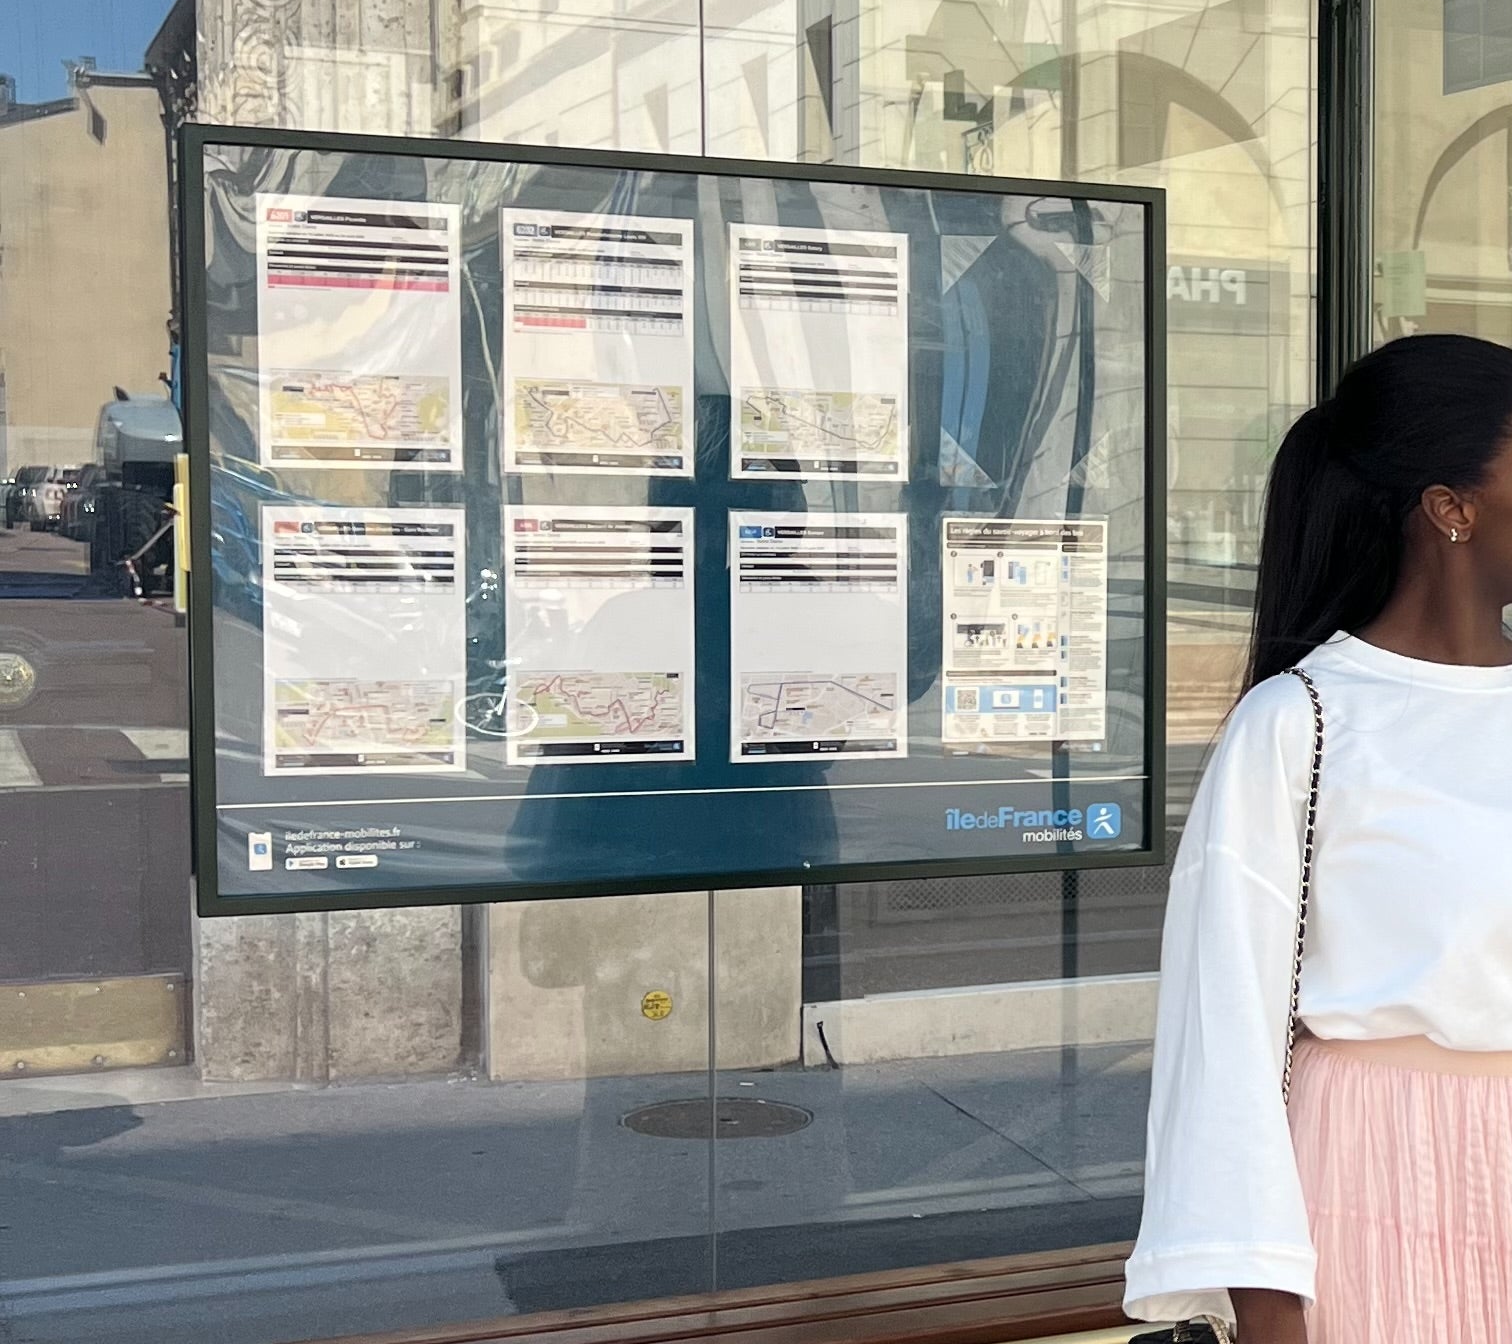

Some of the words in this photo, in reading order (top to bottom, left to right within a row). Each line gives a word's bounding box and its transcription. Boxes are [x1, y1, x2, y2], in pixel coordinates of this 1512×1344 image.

[1022, 827, 1083, 842] mobilités
[285, 842, 343, 855] Application
[344, 840, 397, 854] disponible
[399, 840, 415, 850] sur
